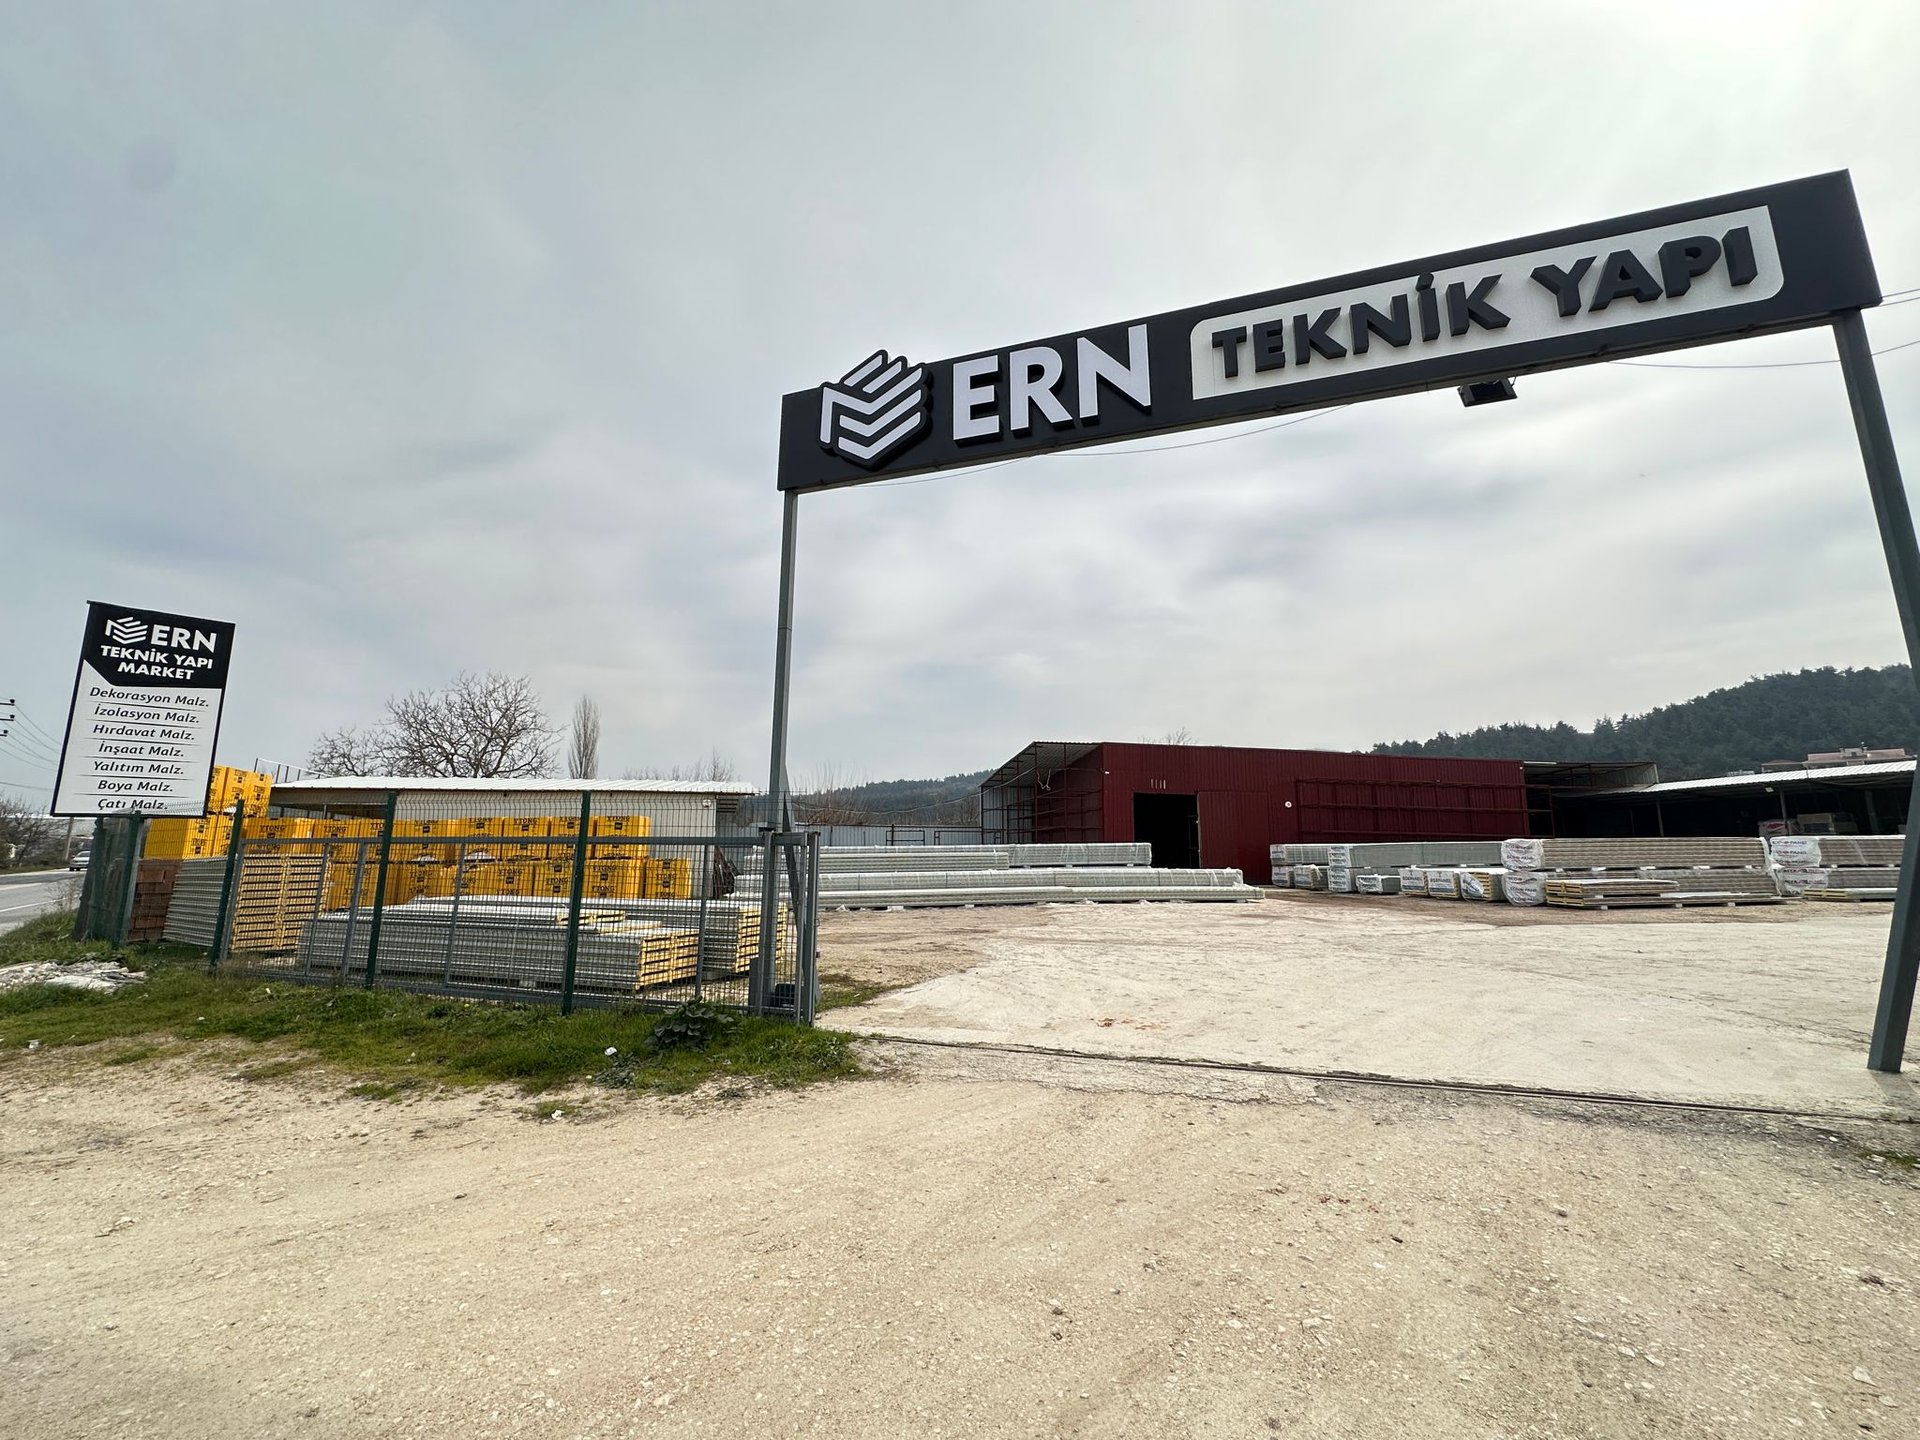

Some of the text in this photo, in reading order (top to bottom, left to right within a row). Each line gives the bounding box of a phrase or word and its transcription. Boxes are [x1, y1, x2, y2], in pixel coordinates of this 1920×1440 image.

[952, 226, 1758, 442] ERN TEKNİK YAPI
[150, 623, 217, 653] ERN
[100, 645, 213, 669] TEKNİK YAPI
[117, 662, 194, 680] MARKET
[89, 687, 209, 707] Dekorasyon Malz.
[94, 703, 200, 723] İzolasyon Malz.
[93, 724, 195, 741] Hırdavat Malz.
[98, 741, 184, 757] İnşaat Malz.
[94, 761, 184, 775] Yalıtım Malz.
[98, 780, 173, 793] Boya Malz.
[98, 799, 168, 811] Çatı Malz.
